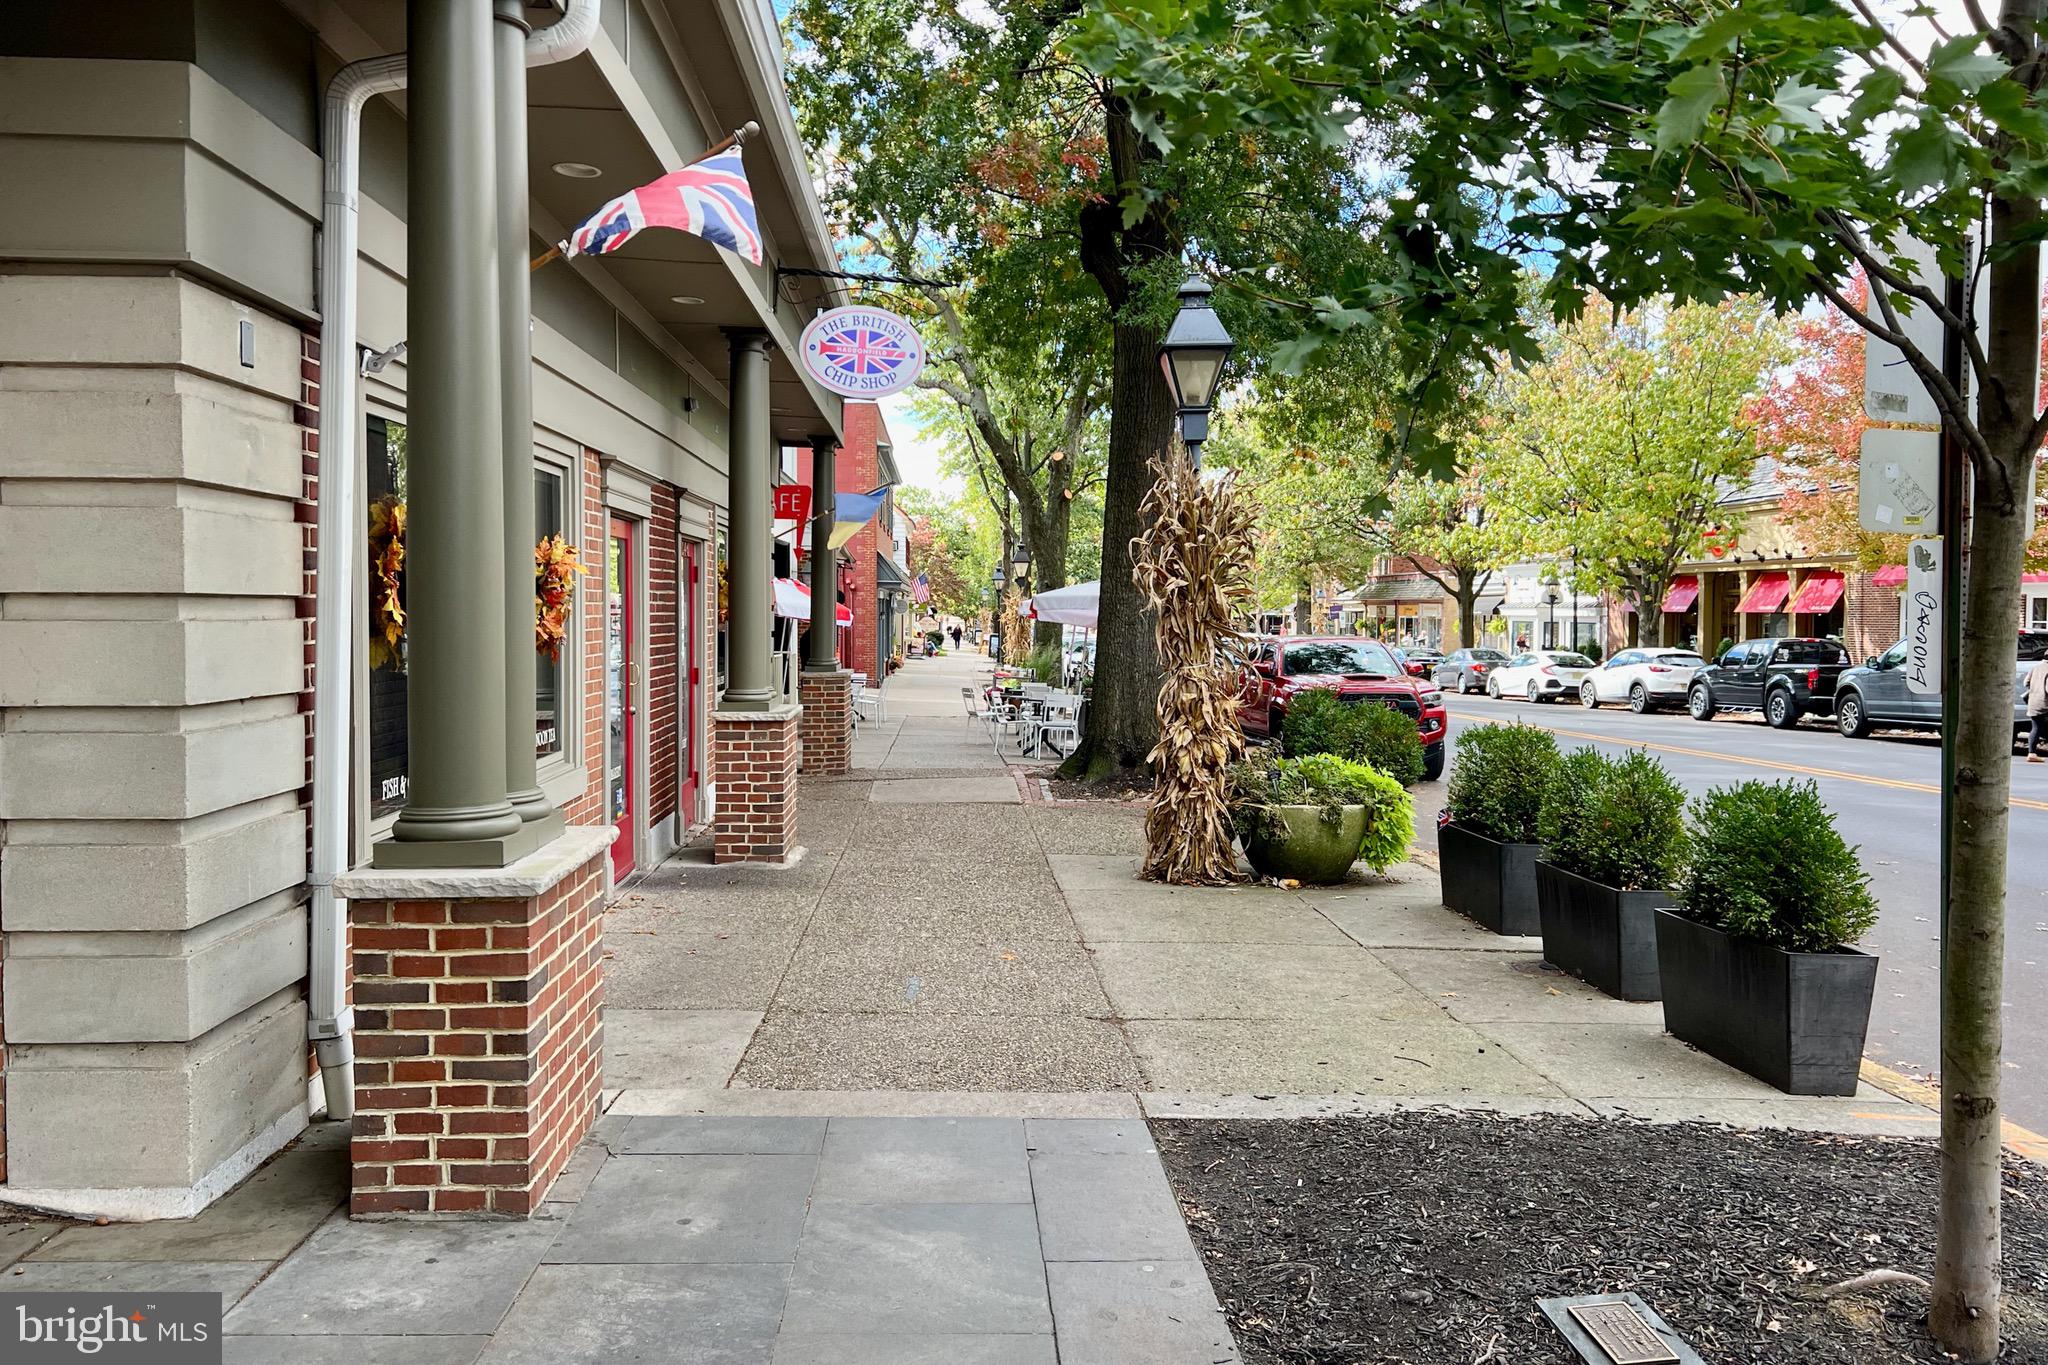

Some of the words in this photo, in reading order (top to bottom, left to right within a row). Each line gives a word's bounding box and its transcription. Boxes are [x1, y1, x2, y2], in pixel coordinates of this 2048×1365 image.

[819, 316, 848, 338] THE
[852, 315, 907, 342] BRITISH
[824, 365, 857, 388] CHIP
[861, 371, 897, 389] SHOP
[382, 776, 400, 801] FISH
[400, 774, 407, 799] &
